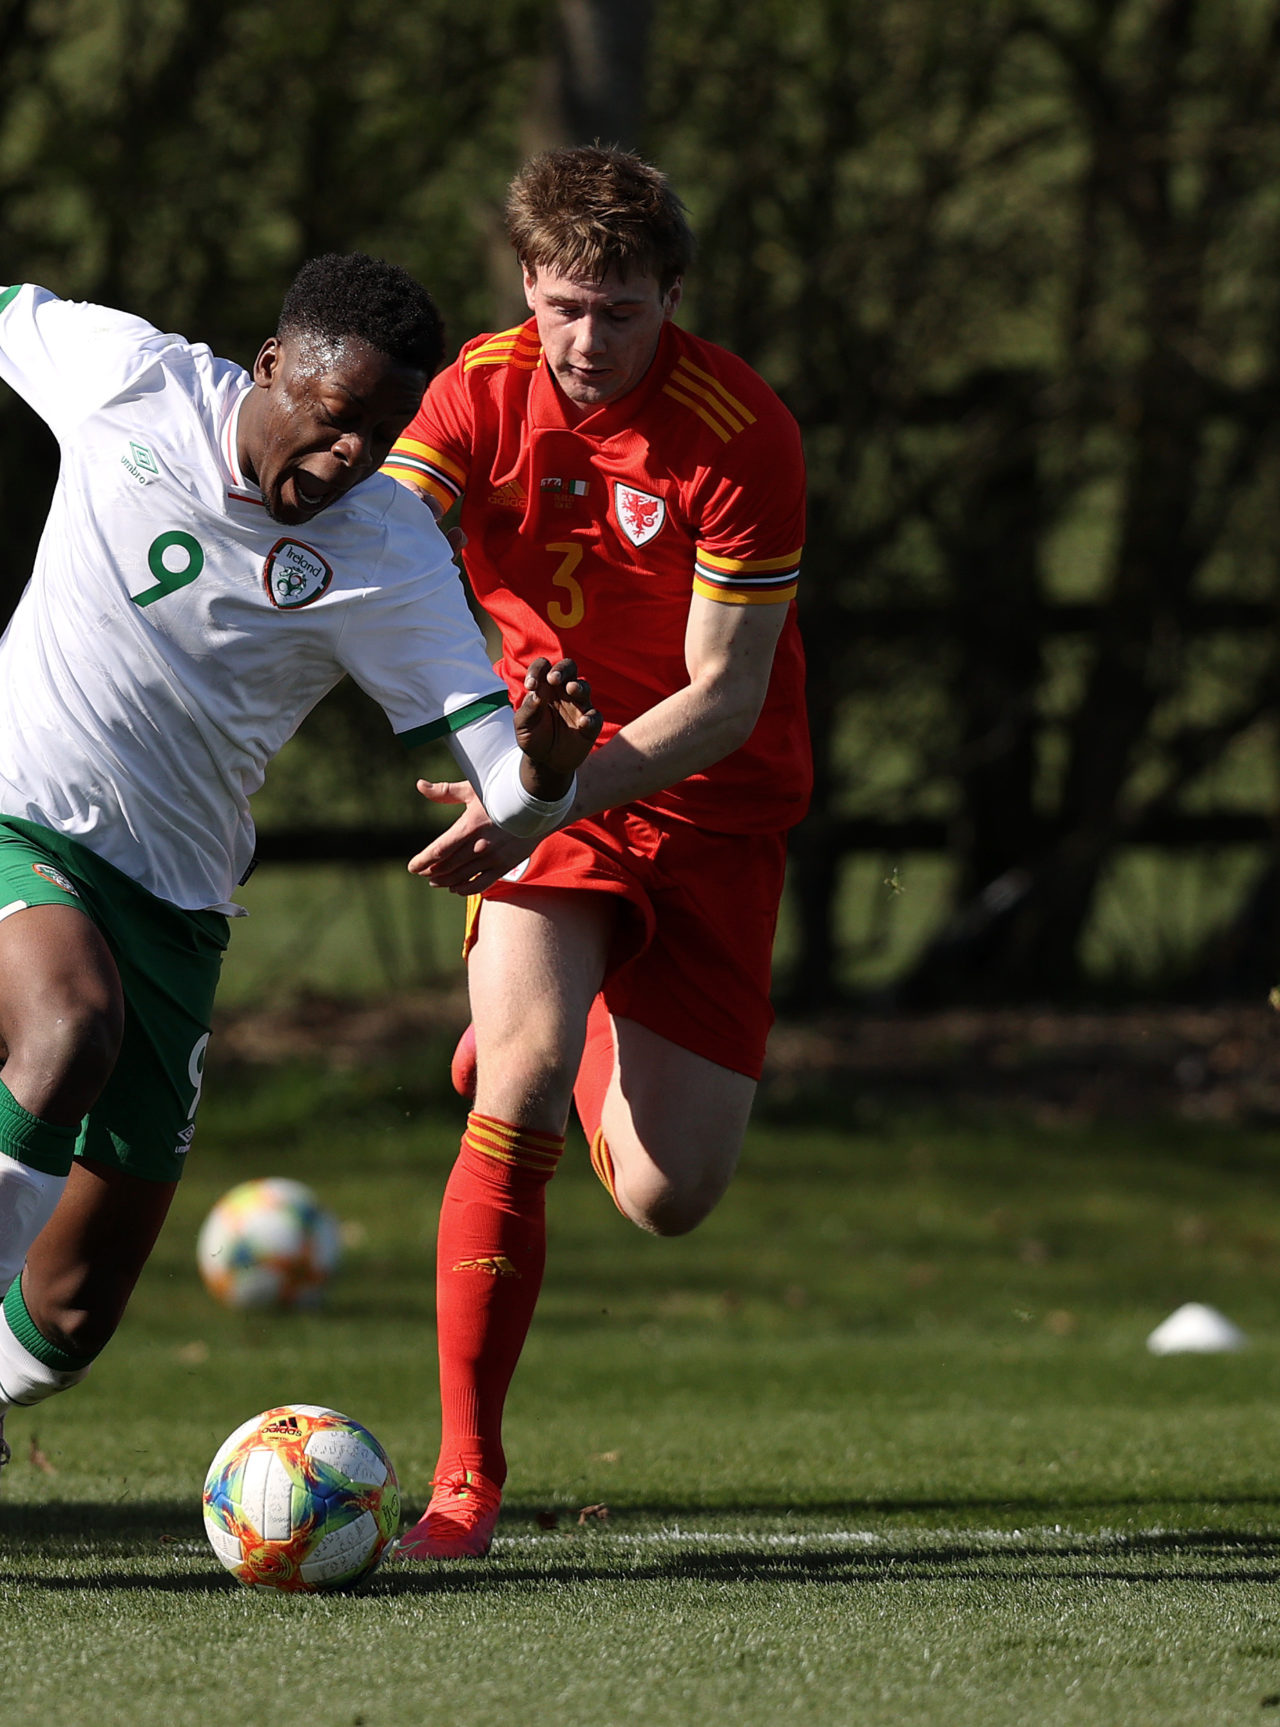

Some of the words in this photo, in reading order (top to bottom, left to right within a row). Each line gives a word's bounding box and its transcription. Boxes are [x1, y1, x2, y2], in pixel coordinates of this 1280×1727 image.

[120, 455, 146, 484] umbro
[487, 496, 530, 508] adida
[130, 530, 205, 608] 9
[286, 546, 323, 577] Ireland
[545, 542, 585, 629] 3
[261, 1424, 303, 1438] adidas
